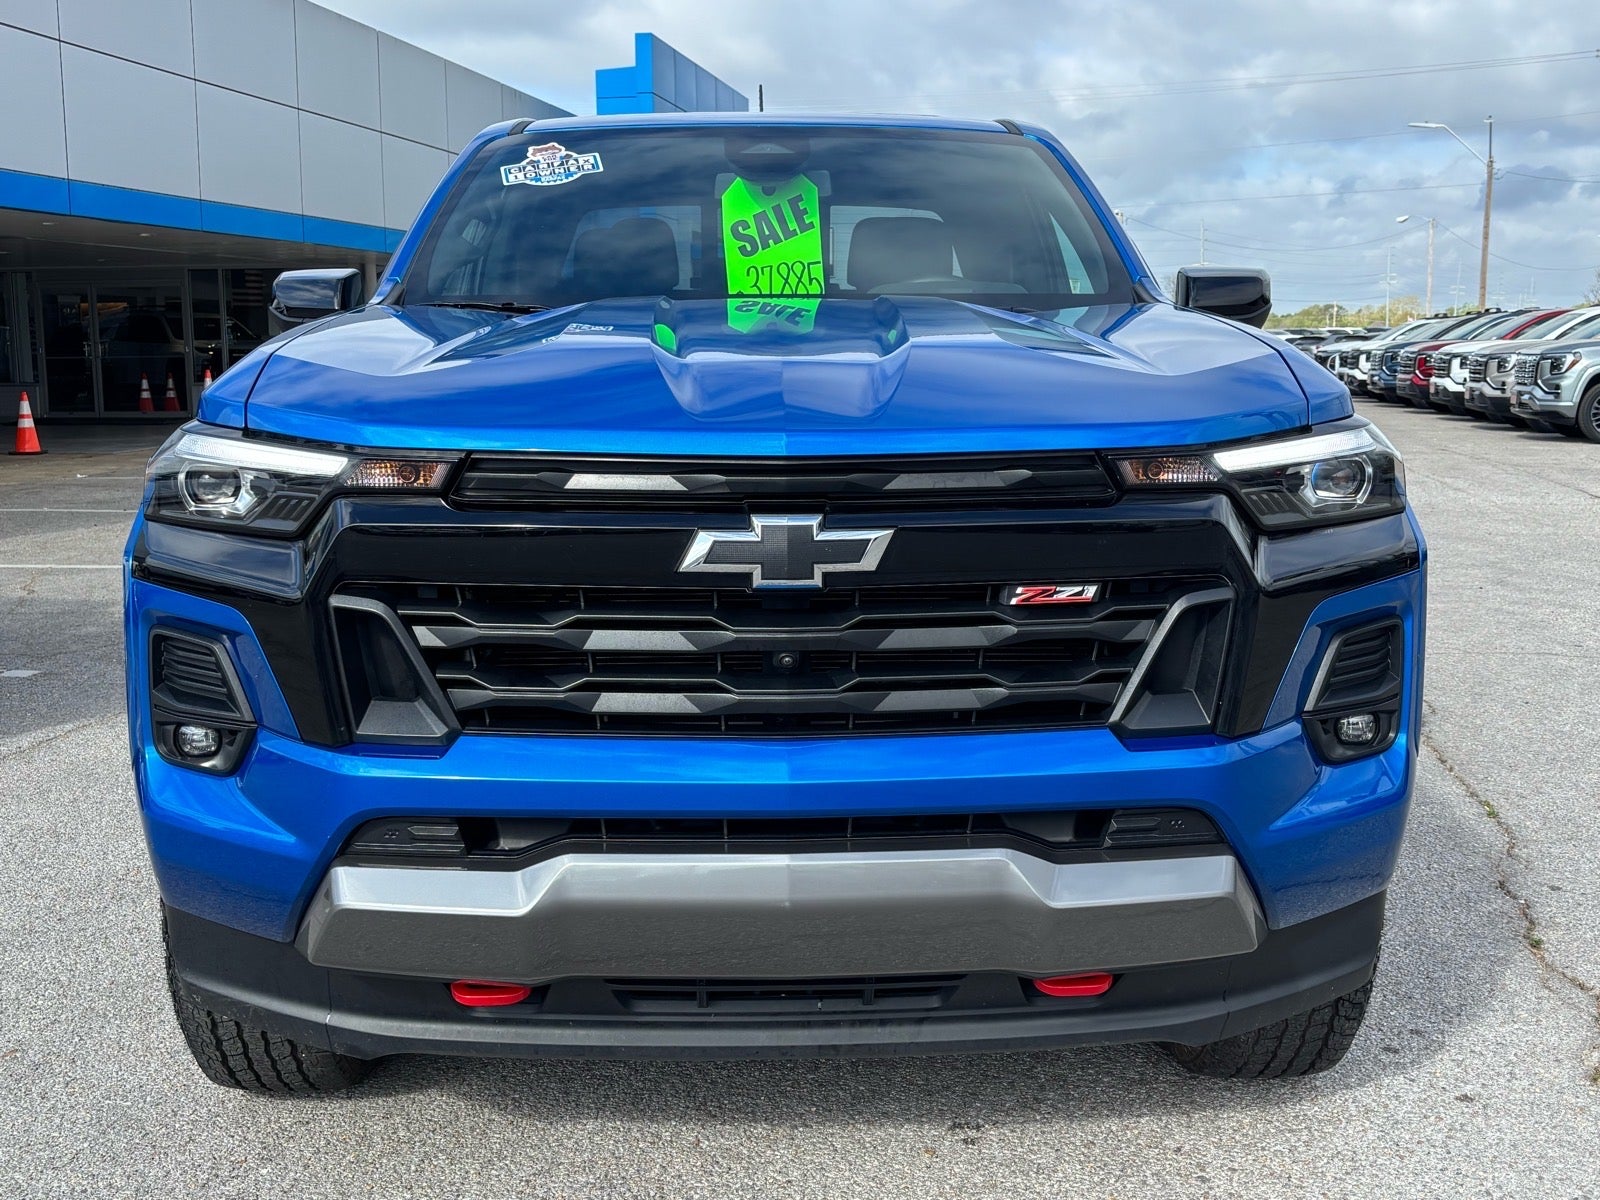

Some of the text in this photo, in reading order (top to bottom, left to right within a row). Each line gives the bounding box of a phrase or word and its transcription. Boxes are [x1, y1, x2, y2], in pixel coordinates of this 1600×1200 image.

[509, 157, 593, 174] CARFAX
[525, 164, 594, 179] OWNER
[730, 193, 816, 258] SALE
[1010, 584, 1099, 605] Z71
